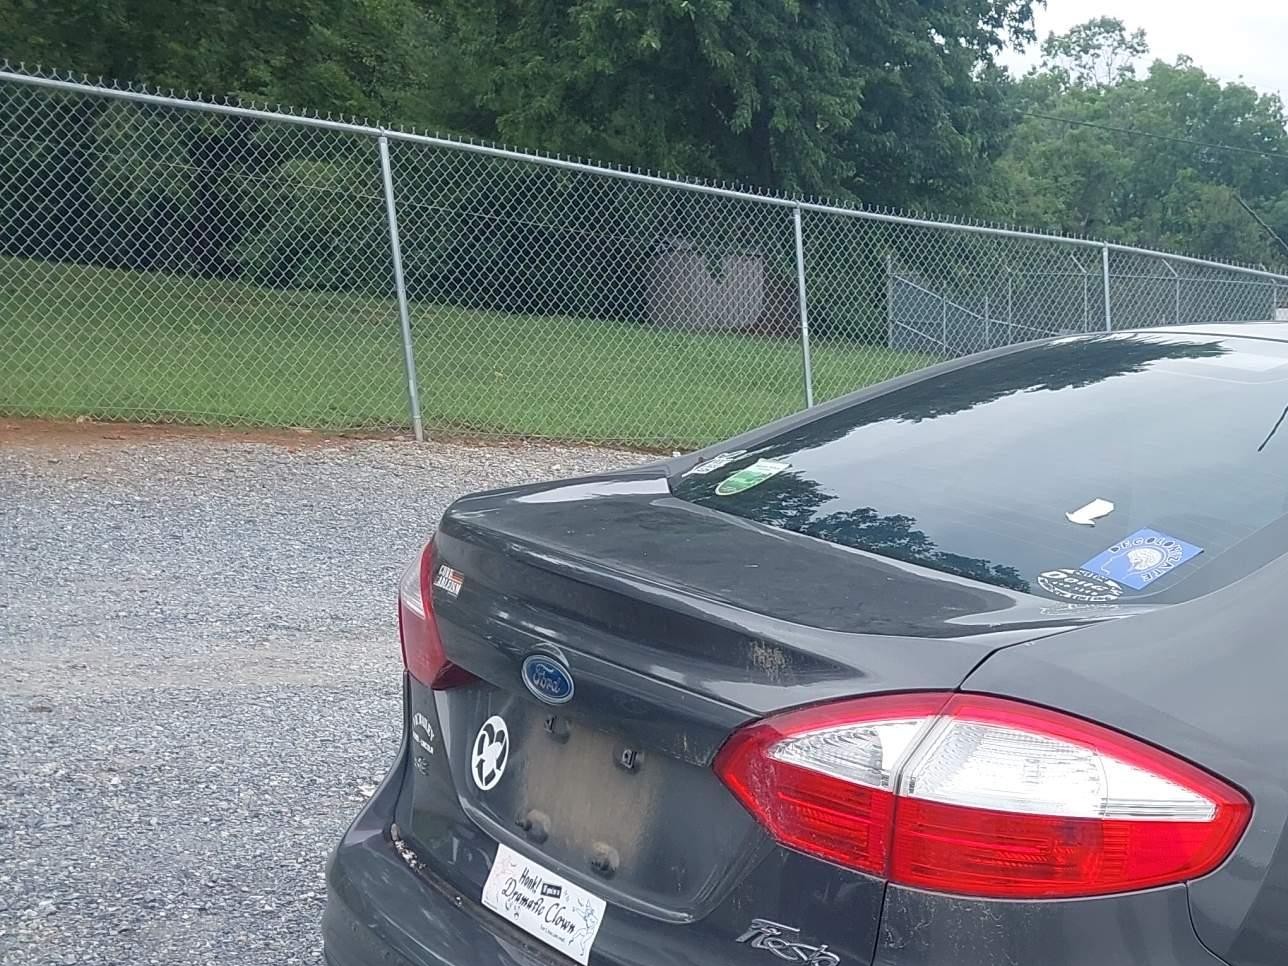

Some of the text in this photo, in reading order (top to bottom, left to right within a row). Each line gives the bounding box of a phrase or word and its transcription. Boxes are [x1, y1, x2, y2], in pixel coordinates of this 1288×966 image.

[532, 663, 561, 694] Ford
[518, 866, 543, 894] Honk!
[501, 876, 546, 917] Dramatic
[544, 902, 576, 935] Clown
